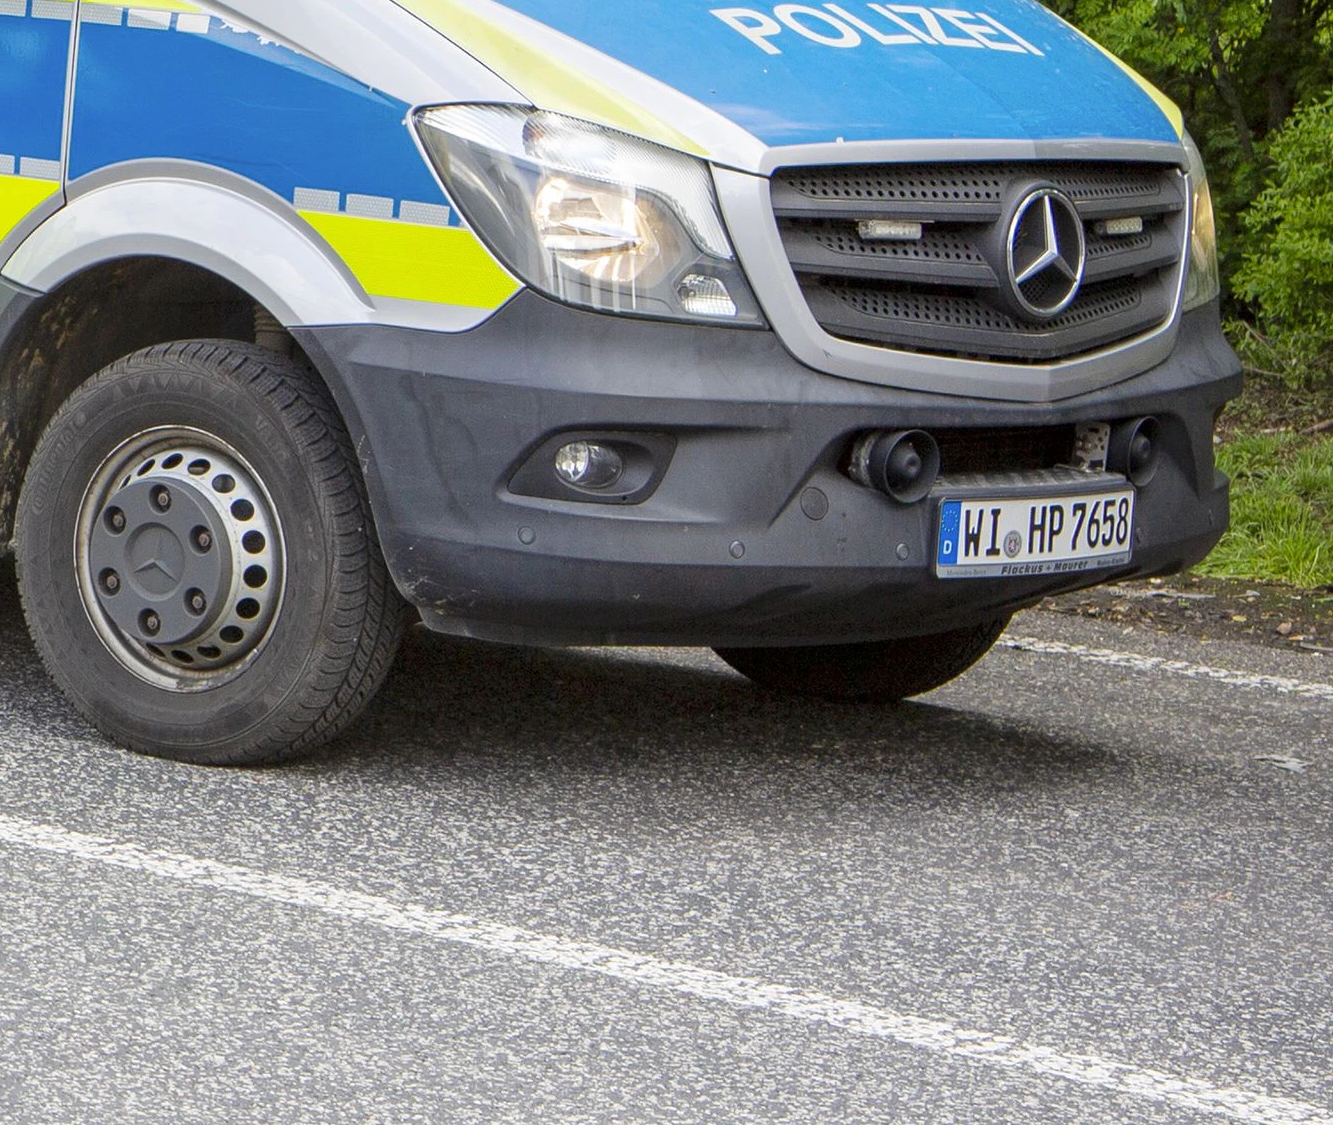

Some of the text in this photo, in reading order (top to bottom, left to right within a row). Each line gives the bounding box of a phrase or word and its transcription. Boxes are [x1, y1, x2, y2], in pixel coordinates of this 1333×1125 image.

[709, 3, 1045, 57] POLIZEI
[964, 497, 1129, 557] WI HP 7658
[943, 540, 952, 555] D
[1001, 564, 1043, 575] Flackus
[1054, 560, 1088, 571] Maurer
